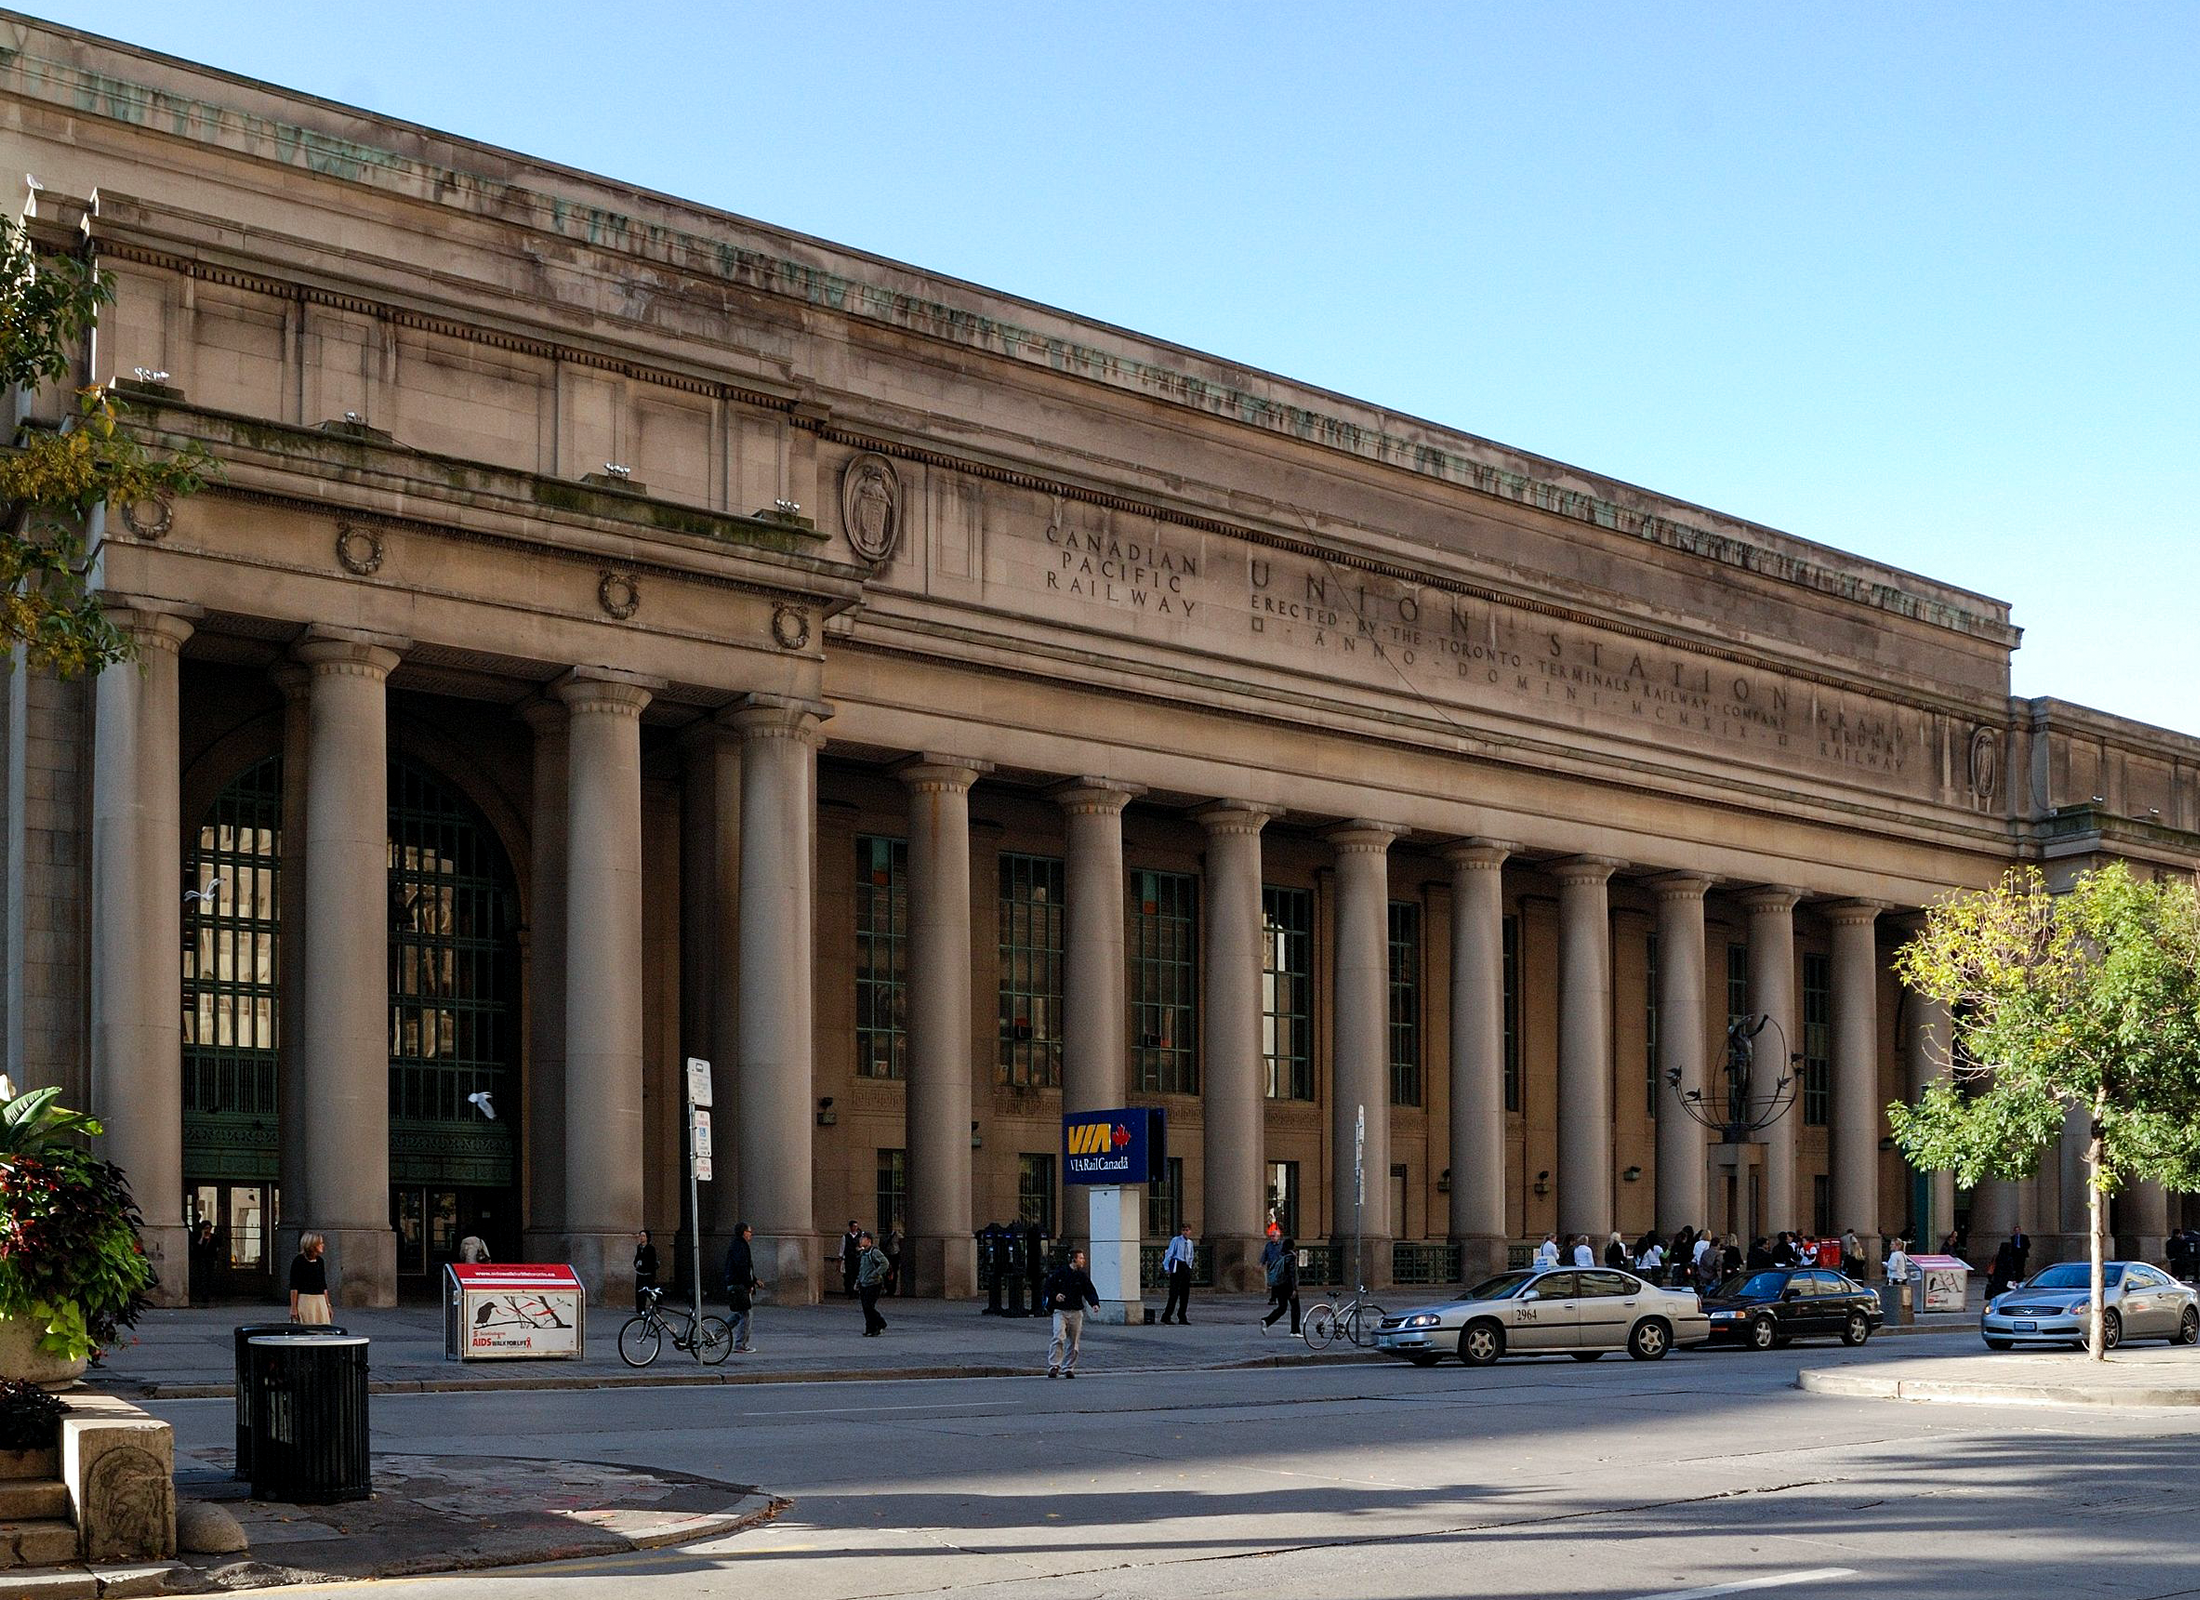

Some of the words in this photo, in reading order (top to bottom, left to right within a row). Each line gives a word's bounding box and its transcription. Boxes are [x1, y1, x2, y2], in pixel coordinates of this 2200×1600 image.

[1046, 525, 1196, 577] CANADIAN
[1062, 551, 1181, 593] PACIFIC
[1047, 571, 1195, 617] RAILWAY
[1251, 559, 1468, 634] UNION
[1550, 633, 1787, 711] STATION
[1251, 594, 1337, 626] ERECTED
[1358, 619, 1377, 636] BY
[1391, 626, 1422, 646] THE
[1438, 637, 1521, 667] TORONTO
[1538, 659, 1630, 693] TERMINALS
[1643, 685, 1710, 712] RAILWAY
[1315, 631, 1415, 666] ANNO
[1458, 662, 1598, 706] DOMINI
[1632, 700, 1746, 739] MCMXIX
[1820, 742, 1903, 772] RAILWAY
[1068, 1123, 1112, 1155] VIA
[1516, 1309, 1537, 1321] 2964
[472, 1337, 492, 1347] AIDS
